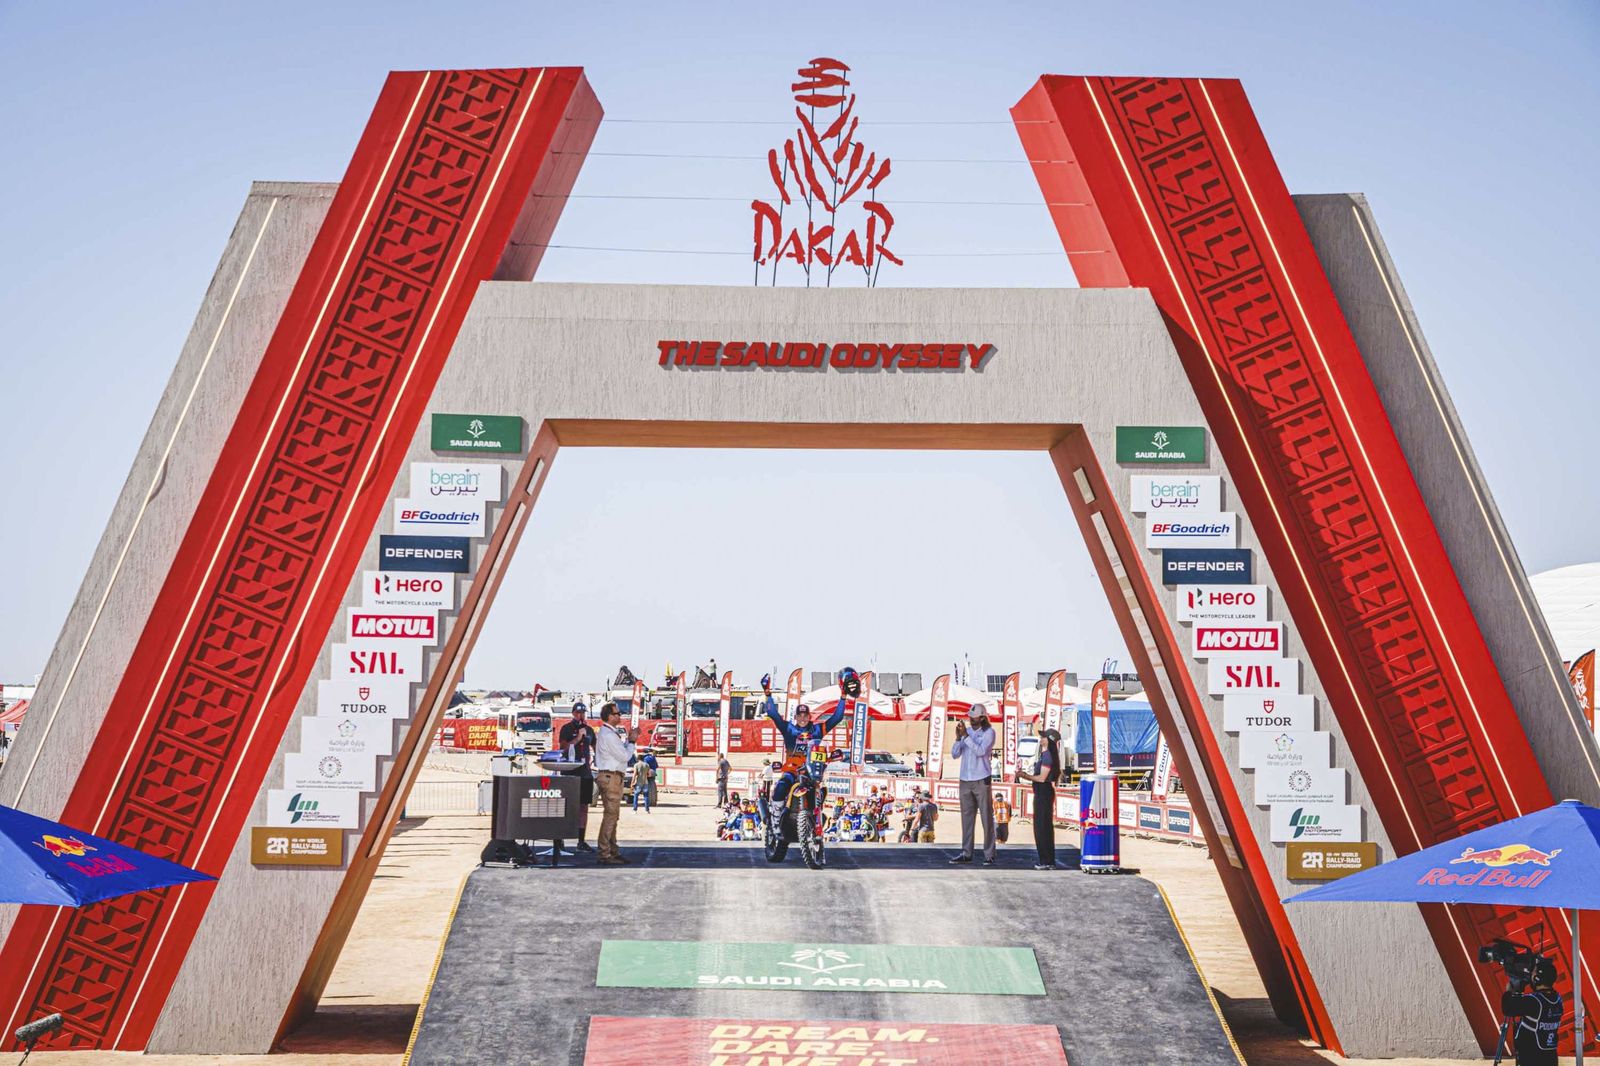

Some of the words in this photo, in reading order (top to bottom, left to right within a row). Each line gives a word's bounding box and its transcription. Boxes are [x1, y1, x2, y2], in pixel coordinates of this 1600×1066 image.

[751, 199, 904, 267] DAKAR
[657, 340, 722, 368] THE
[720, 341, 827, 369] SAUDI
[829, 343, 996, 371] ODYSSEY
[473, 440, 502, 448] ARABIA
[431, 468, 479, 485] berain
[1151, 480, 1199, 497] berain
[401, 510, 480, 522] BFGoodrich
[1152, 523, 1230, 534] BFGoodrich
[385, 547, 464, 560] DEFENDER
[1167, 561, 1245, 572] DEFENDER
[396, 579, 443, 592] Hero
[1209, 592, 1256, 605] Hero
[354, 617, 432, 636] MOTUL
[1200, 630, 1276, 648] MOTUL
[340, 703, 387, 714] TUDOR
[1246, 717, 1292, 727] TUDOR
[854, 704, 865, 763] DEFENDER
[1006, 715, 1016, 765] MOTUL
[528, 789, 562, 798] TUDOR
[939, 787, 960, 799] MOTU
[1088, 808, 1108, 819] Bull
[1417, 867, 1488, 887] Red
[1479, 869, 1552, 889] Bull
[697, 975, 802, 987] SAUDI
[812, 977, 948, 989] ARABIA
[708, 1024, 940, 1043] DREAM.
[708, 1039, 887, 1057] DARE.
